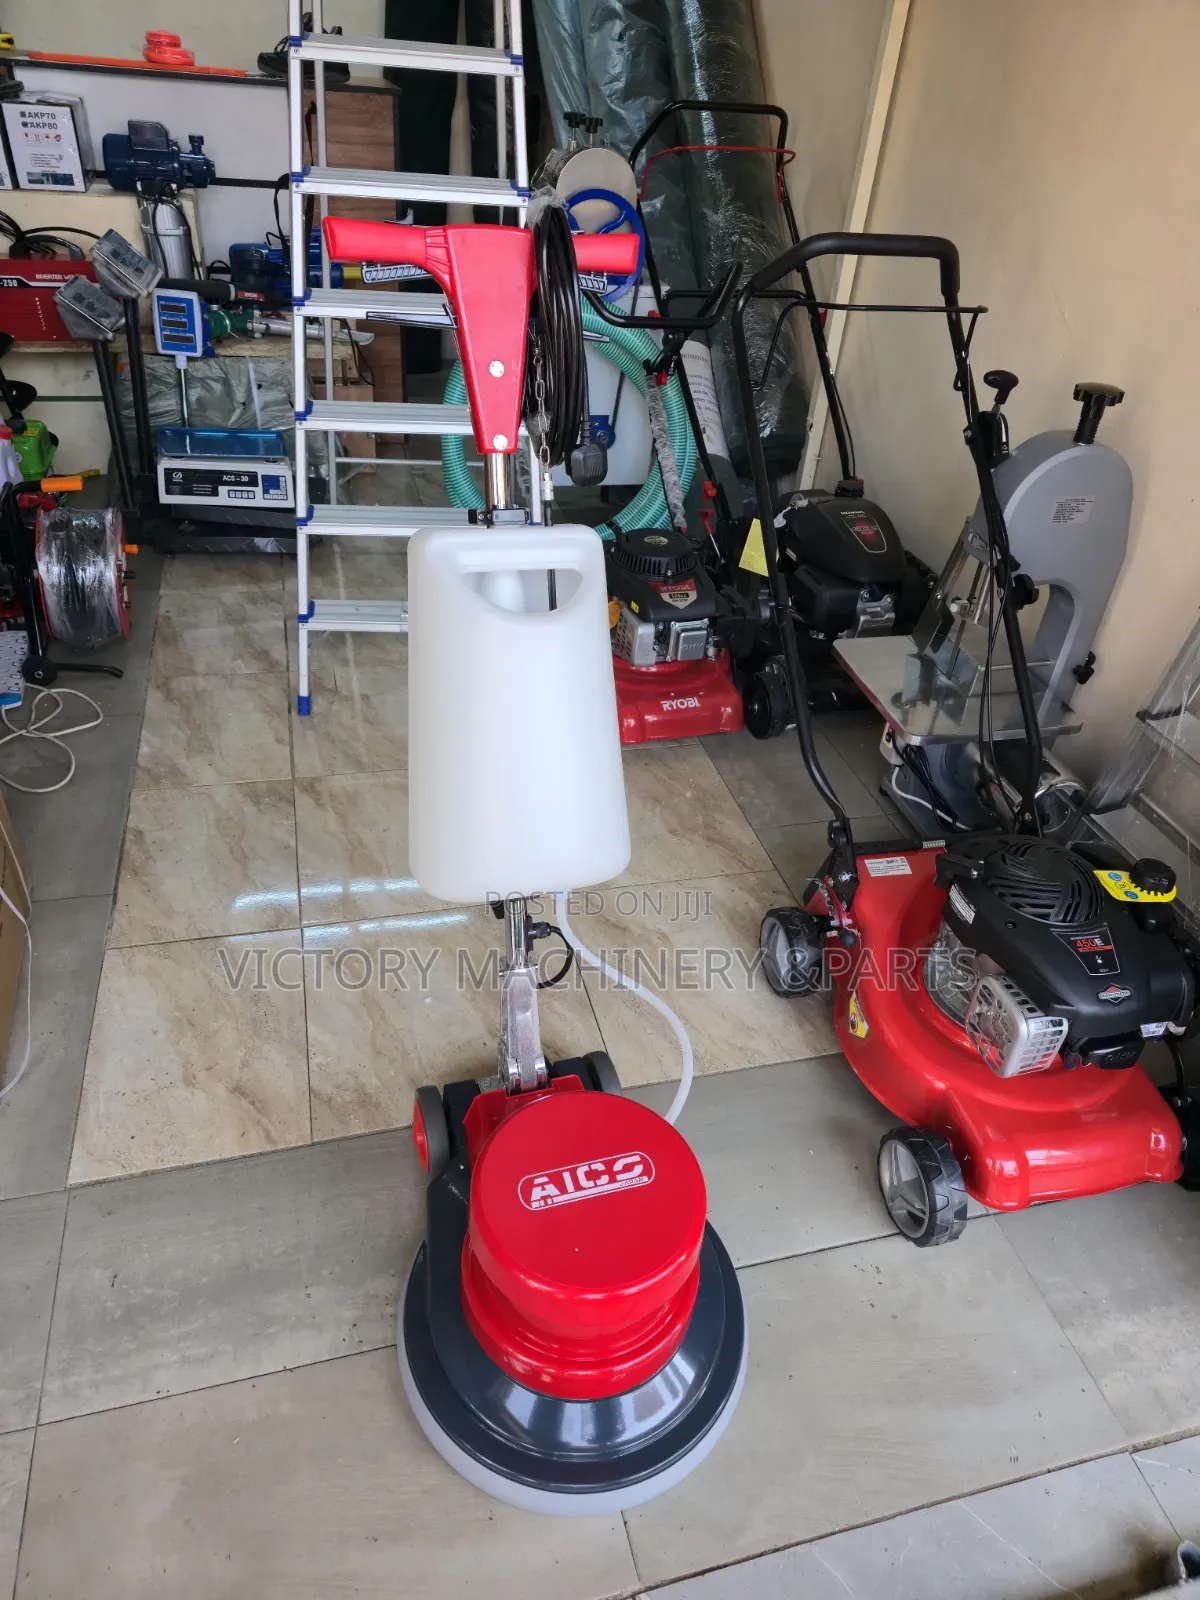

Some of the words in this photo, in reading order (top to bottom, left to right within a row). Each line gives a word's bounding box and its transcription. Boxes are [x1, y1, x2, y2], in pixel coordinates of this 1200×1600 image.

[28, 111, 56, 120] AKP70
[30, 121, 58, 130] AKP80
[660, 697, 702, 712] RYOBI
[1076, 938, 1104, 948] 450E
